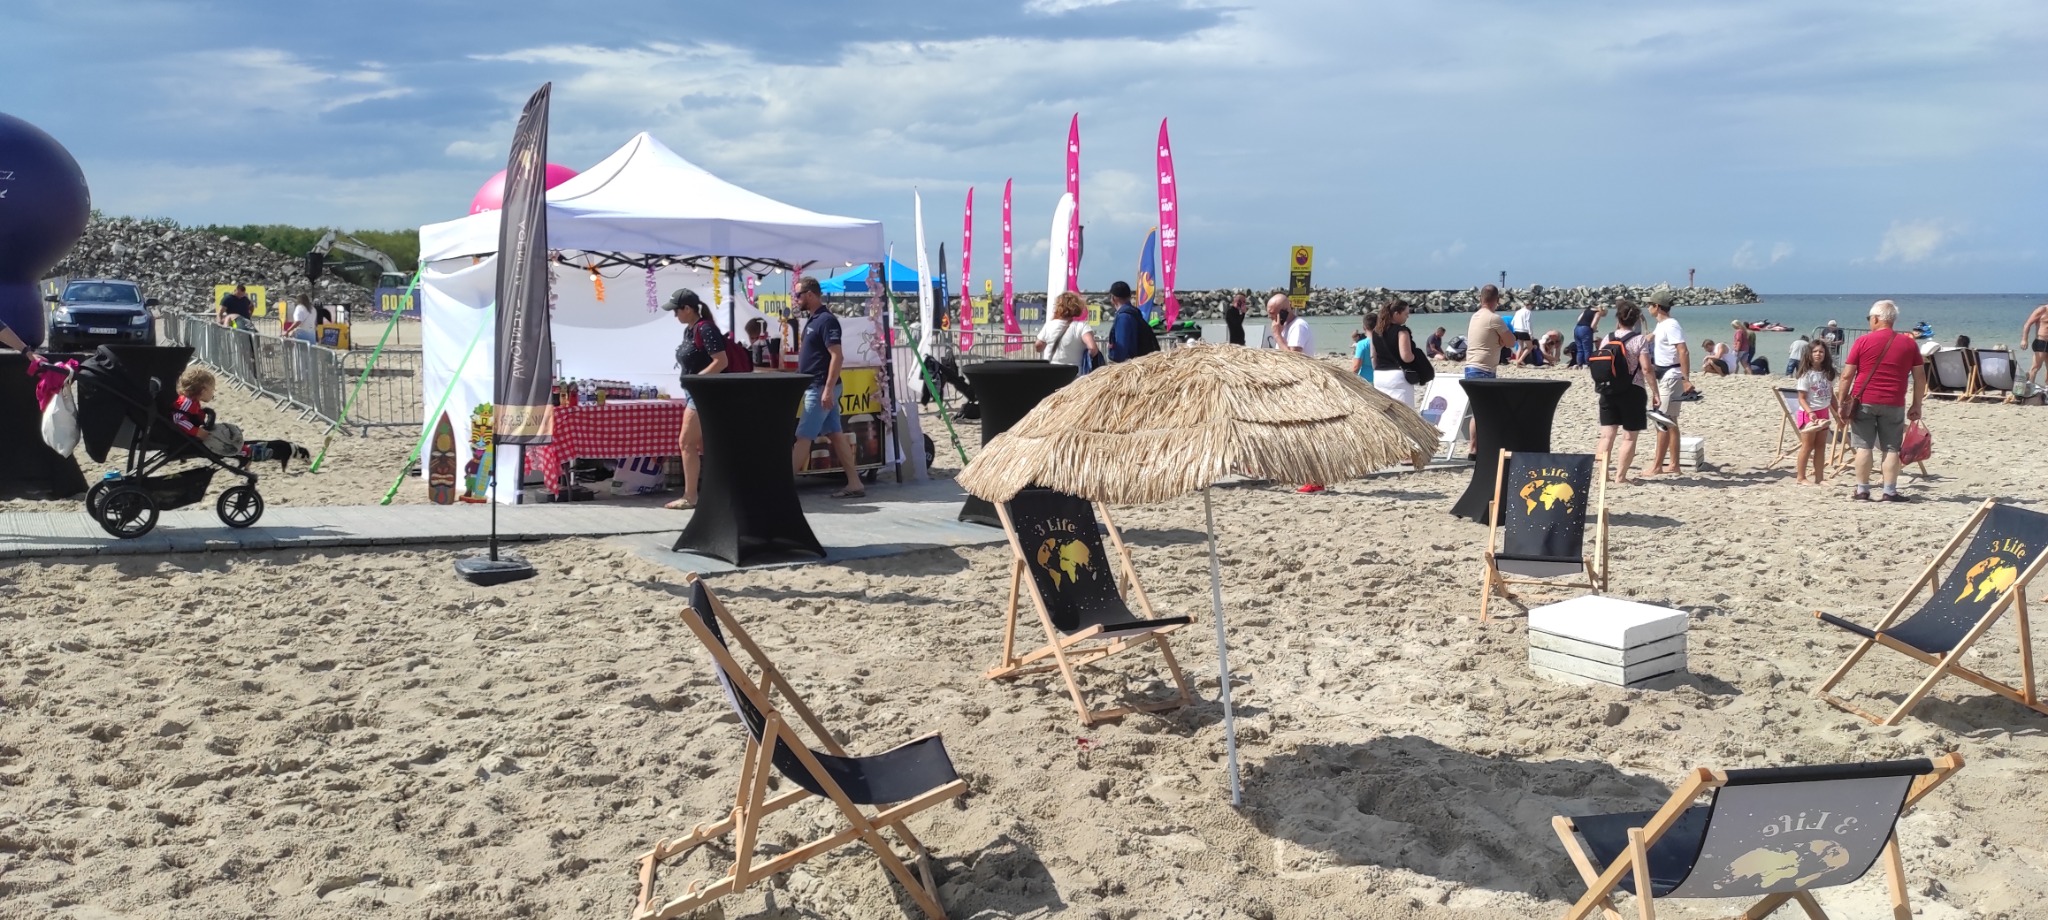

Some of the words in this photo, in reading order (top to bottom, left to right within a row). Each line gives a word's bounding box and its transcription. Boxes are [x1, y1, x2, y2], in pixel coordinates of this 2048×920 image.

[1528, 470, 1538, 479] 3
[1541, 468, 1569, 479] Life
[1034, 524, 1046, 536] 3
[1046, 518, 1076, 533] Life
[1991, 540, 2001, 553] 3
[2002, 538, 2027, 559] Life
